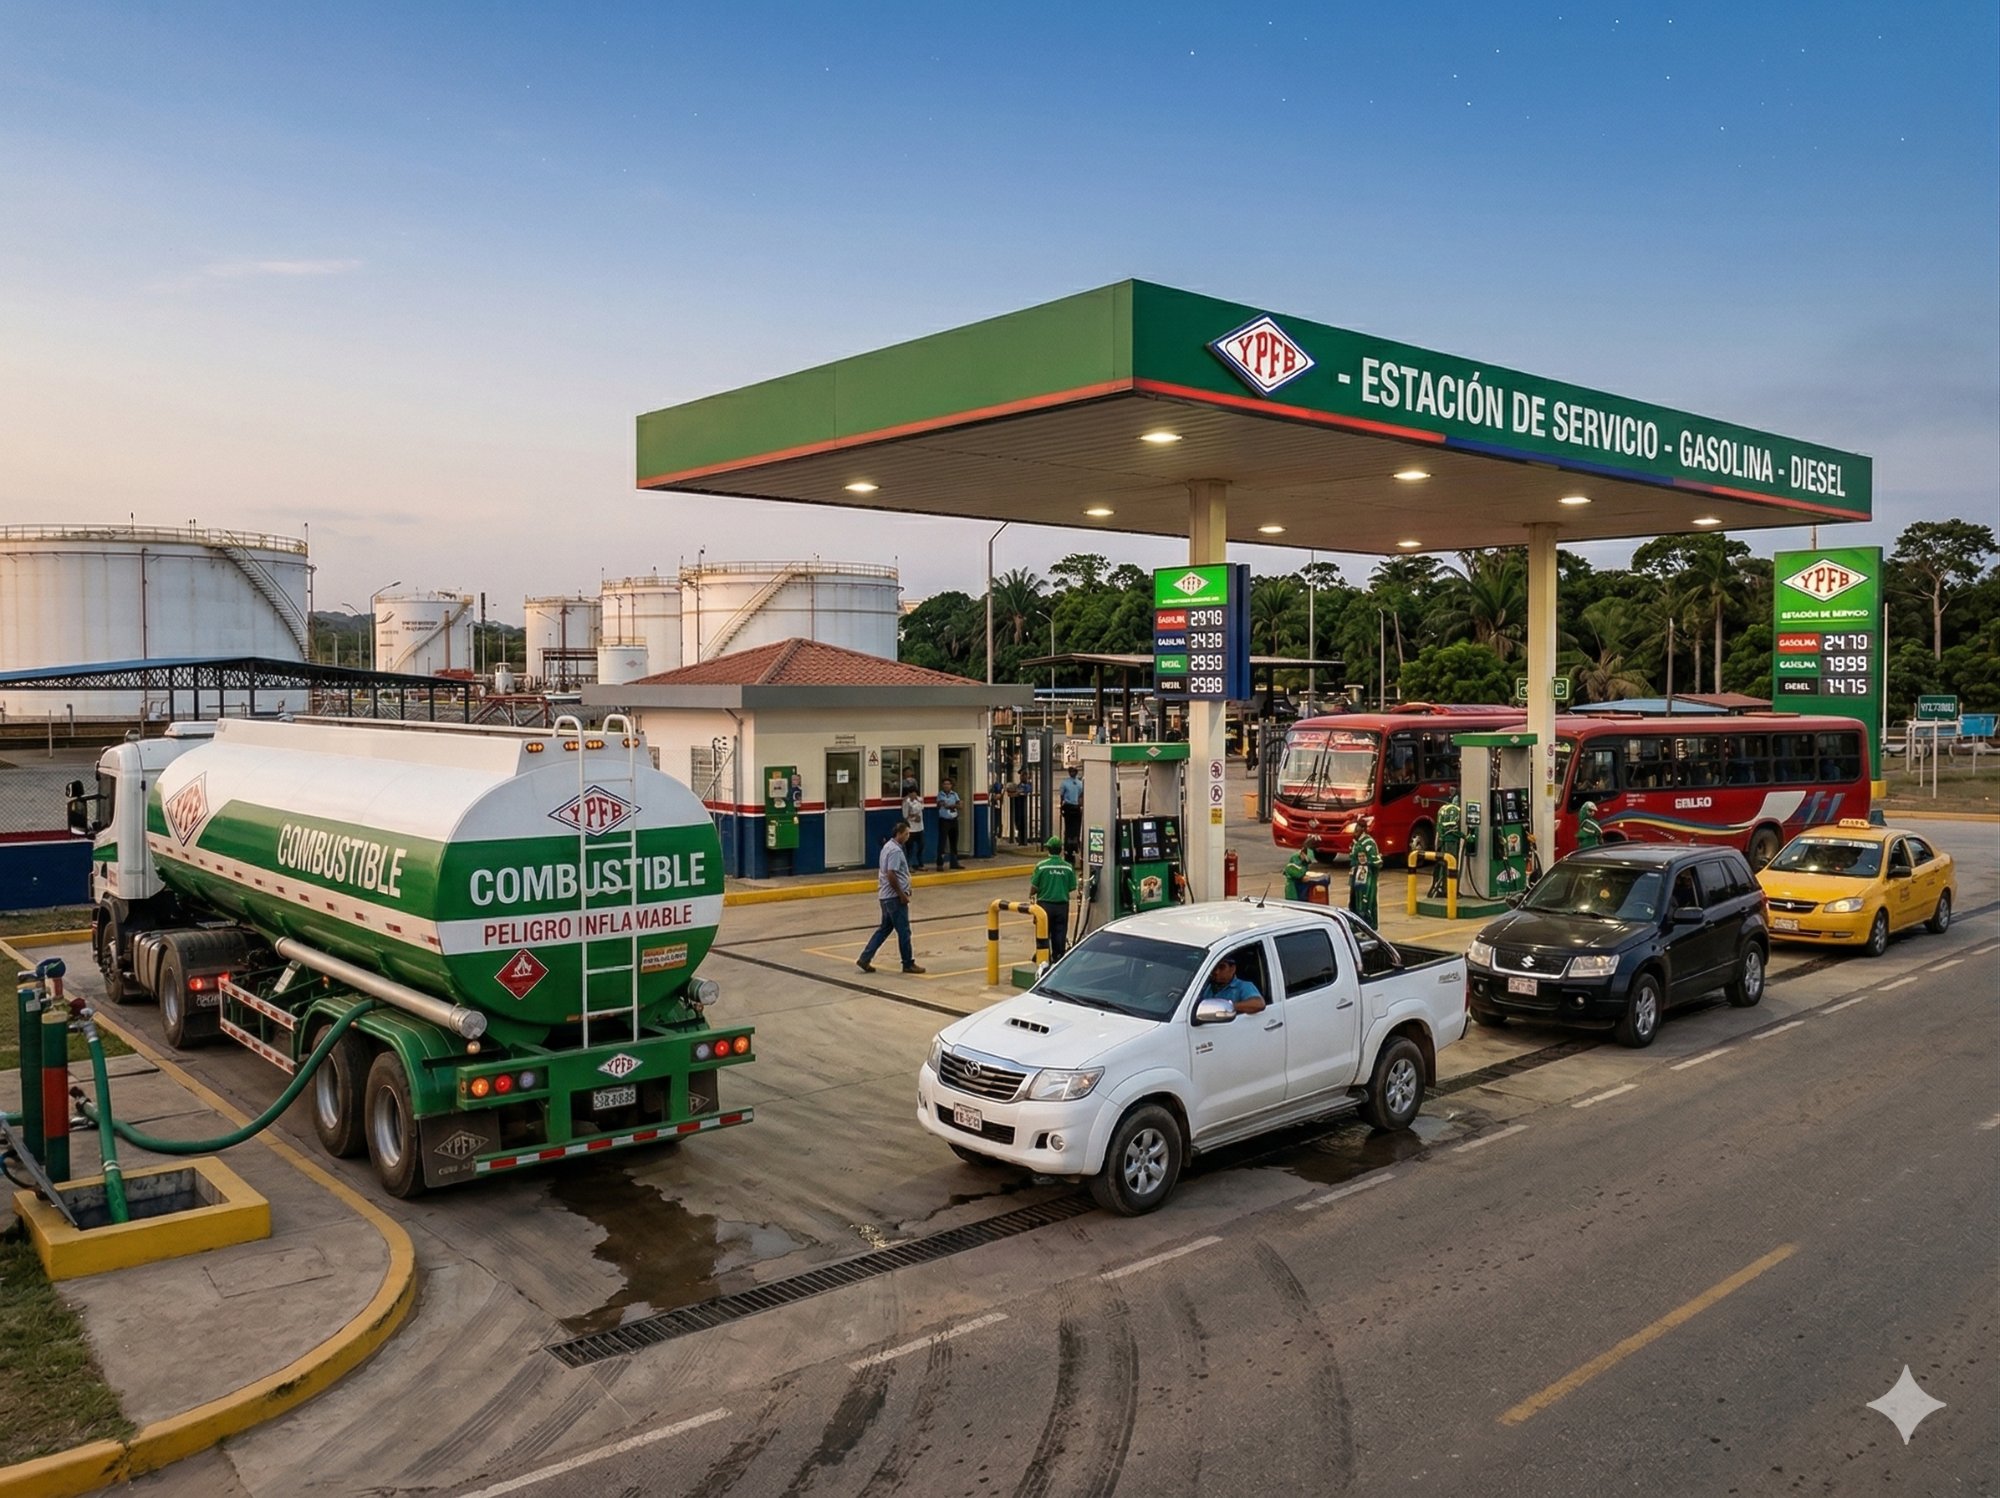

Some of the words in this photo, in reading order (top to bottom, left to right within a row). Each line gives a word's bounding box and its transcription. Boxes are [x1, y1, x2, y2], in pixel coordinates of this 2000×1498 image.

[1237, 331, 1297, 379] YPFB
[1362, 357, 1503, 429] ESTACIÓN
[1513, 391, 1546, 437] DE
[1552, 400, 1658, 460] SERVICIO
[1680, 430, 1774, 484] GASOLINA
[1791, 455, 1846, 497] DIESEL
[1801, 567, 1849, 593] YPFB
[569, 796, 623, 828] YPFB
[277, 823, 407, 898] COMBUSTIBLE
[484, 917, 572, 946] PELIGRO
[578, 904, 693, 937] INFLAMABLE
